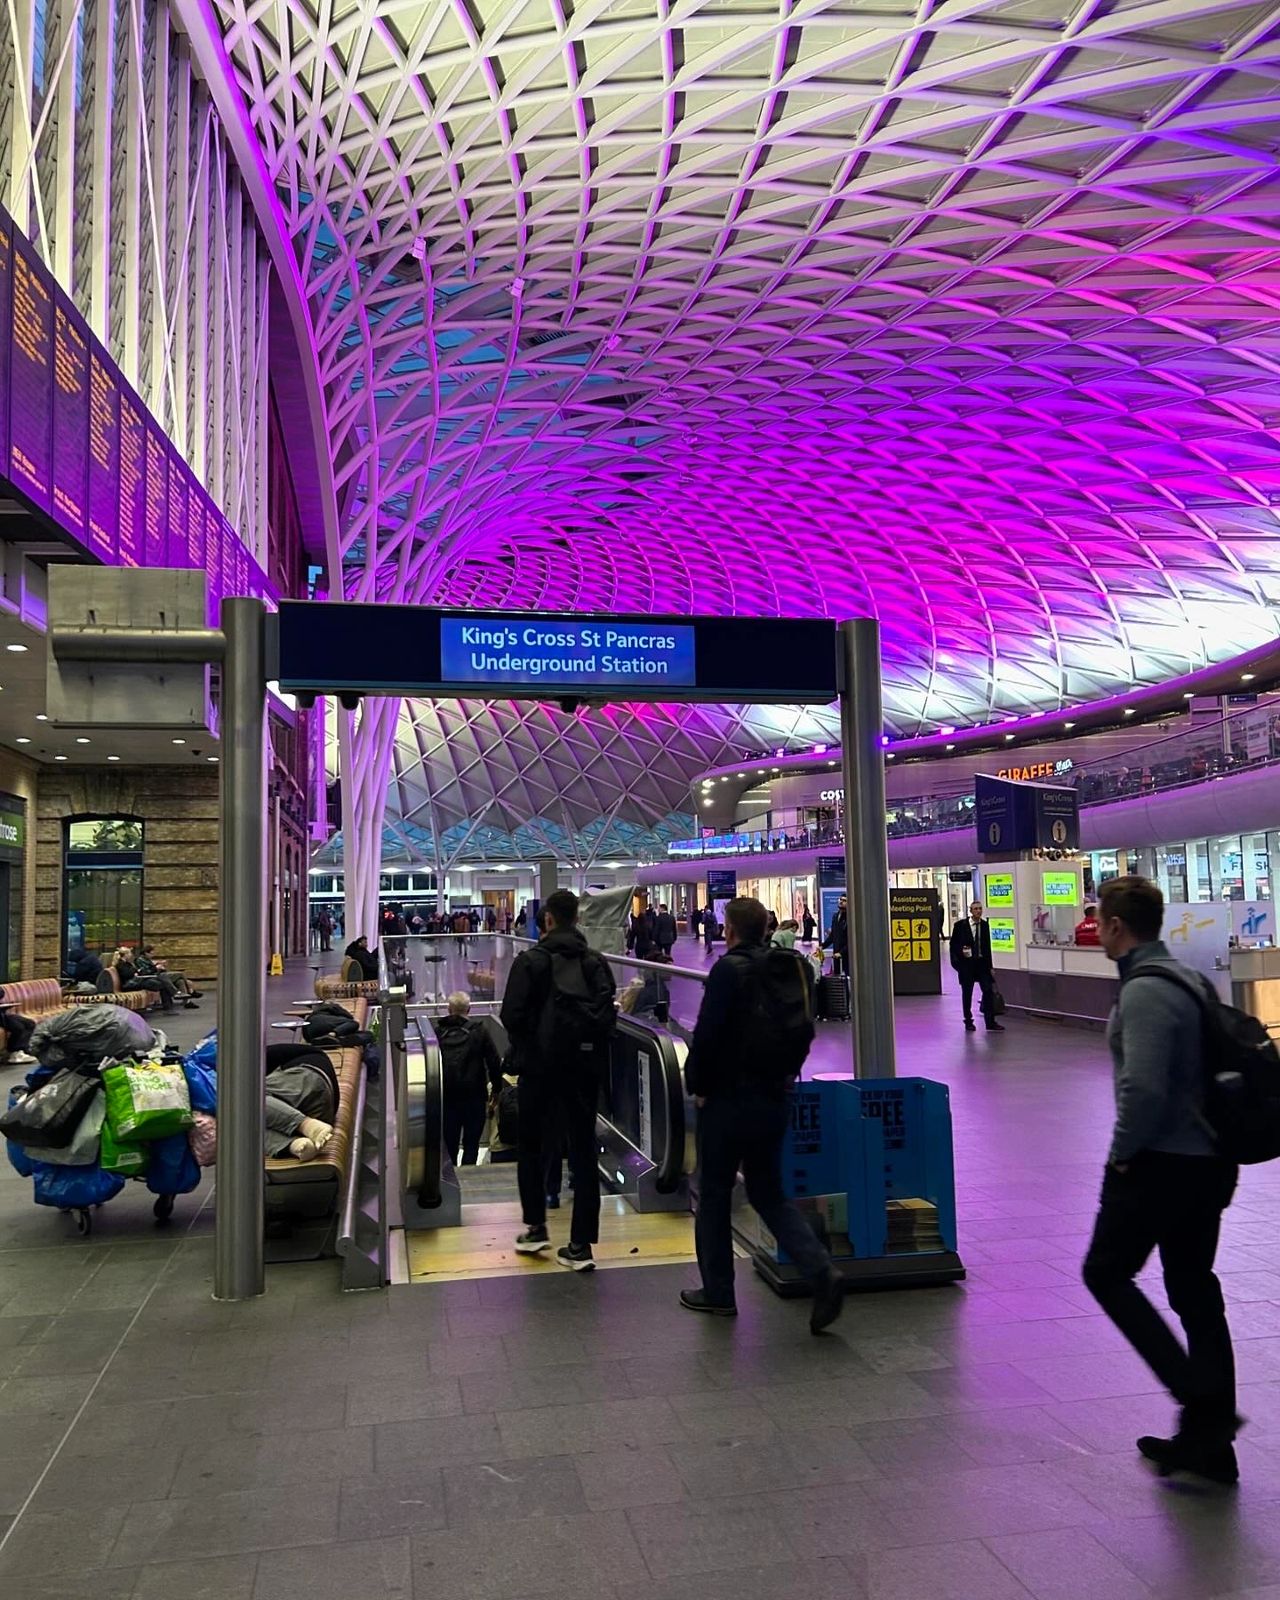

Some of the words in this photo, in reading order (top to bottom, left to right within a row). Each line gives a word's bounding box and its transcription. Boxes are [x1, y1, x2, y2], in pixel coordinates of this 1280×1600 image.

[461, 626, 518, 648] King's
[523, 628, 576, 647] Cross
[580, 629, 601, 648] St
[606, 630, 675, 649] Pancras
[471, 652, 596, 676] Underground
[601, 655, 668, 674] Station
[998, 762, 1053, 781] GIRAFFE
[820, 789, 845, 801] COST
[145, 1081, 172, 1090] HOME
